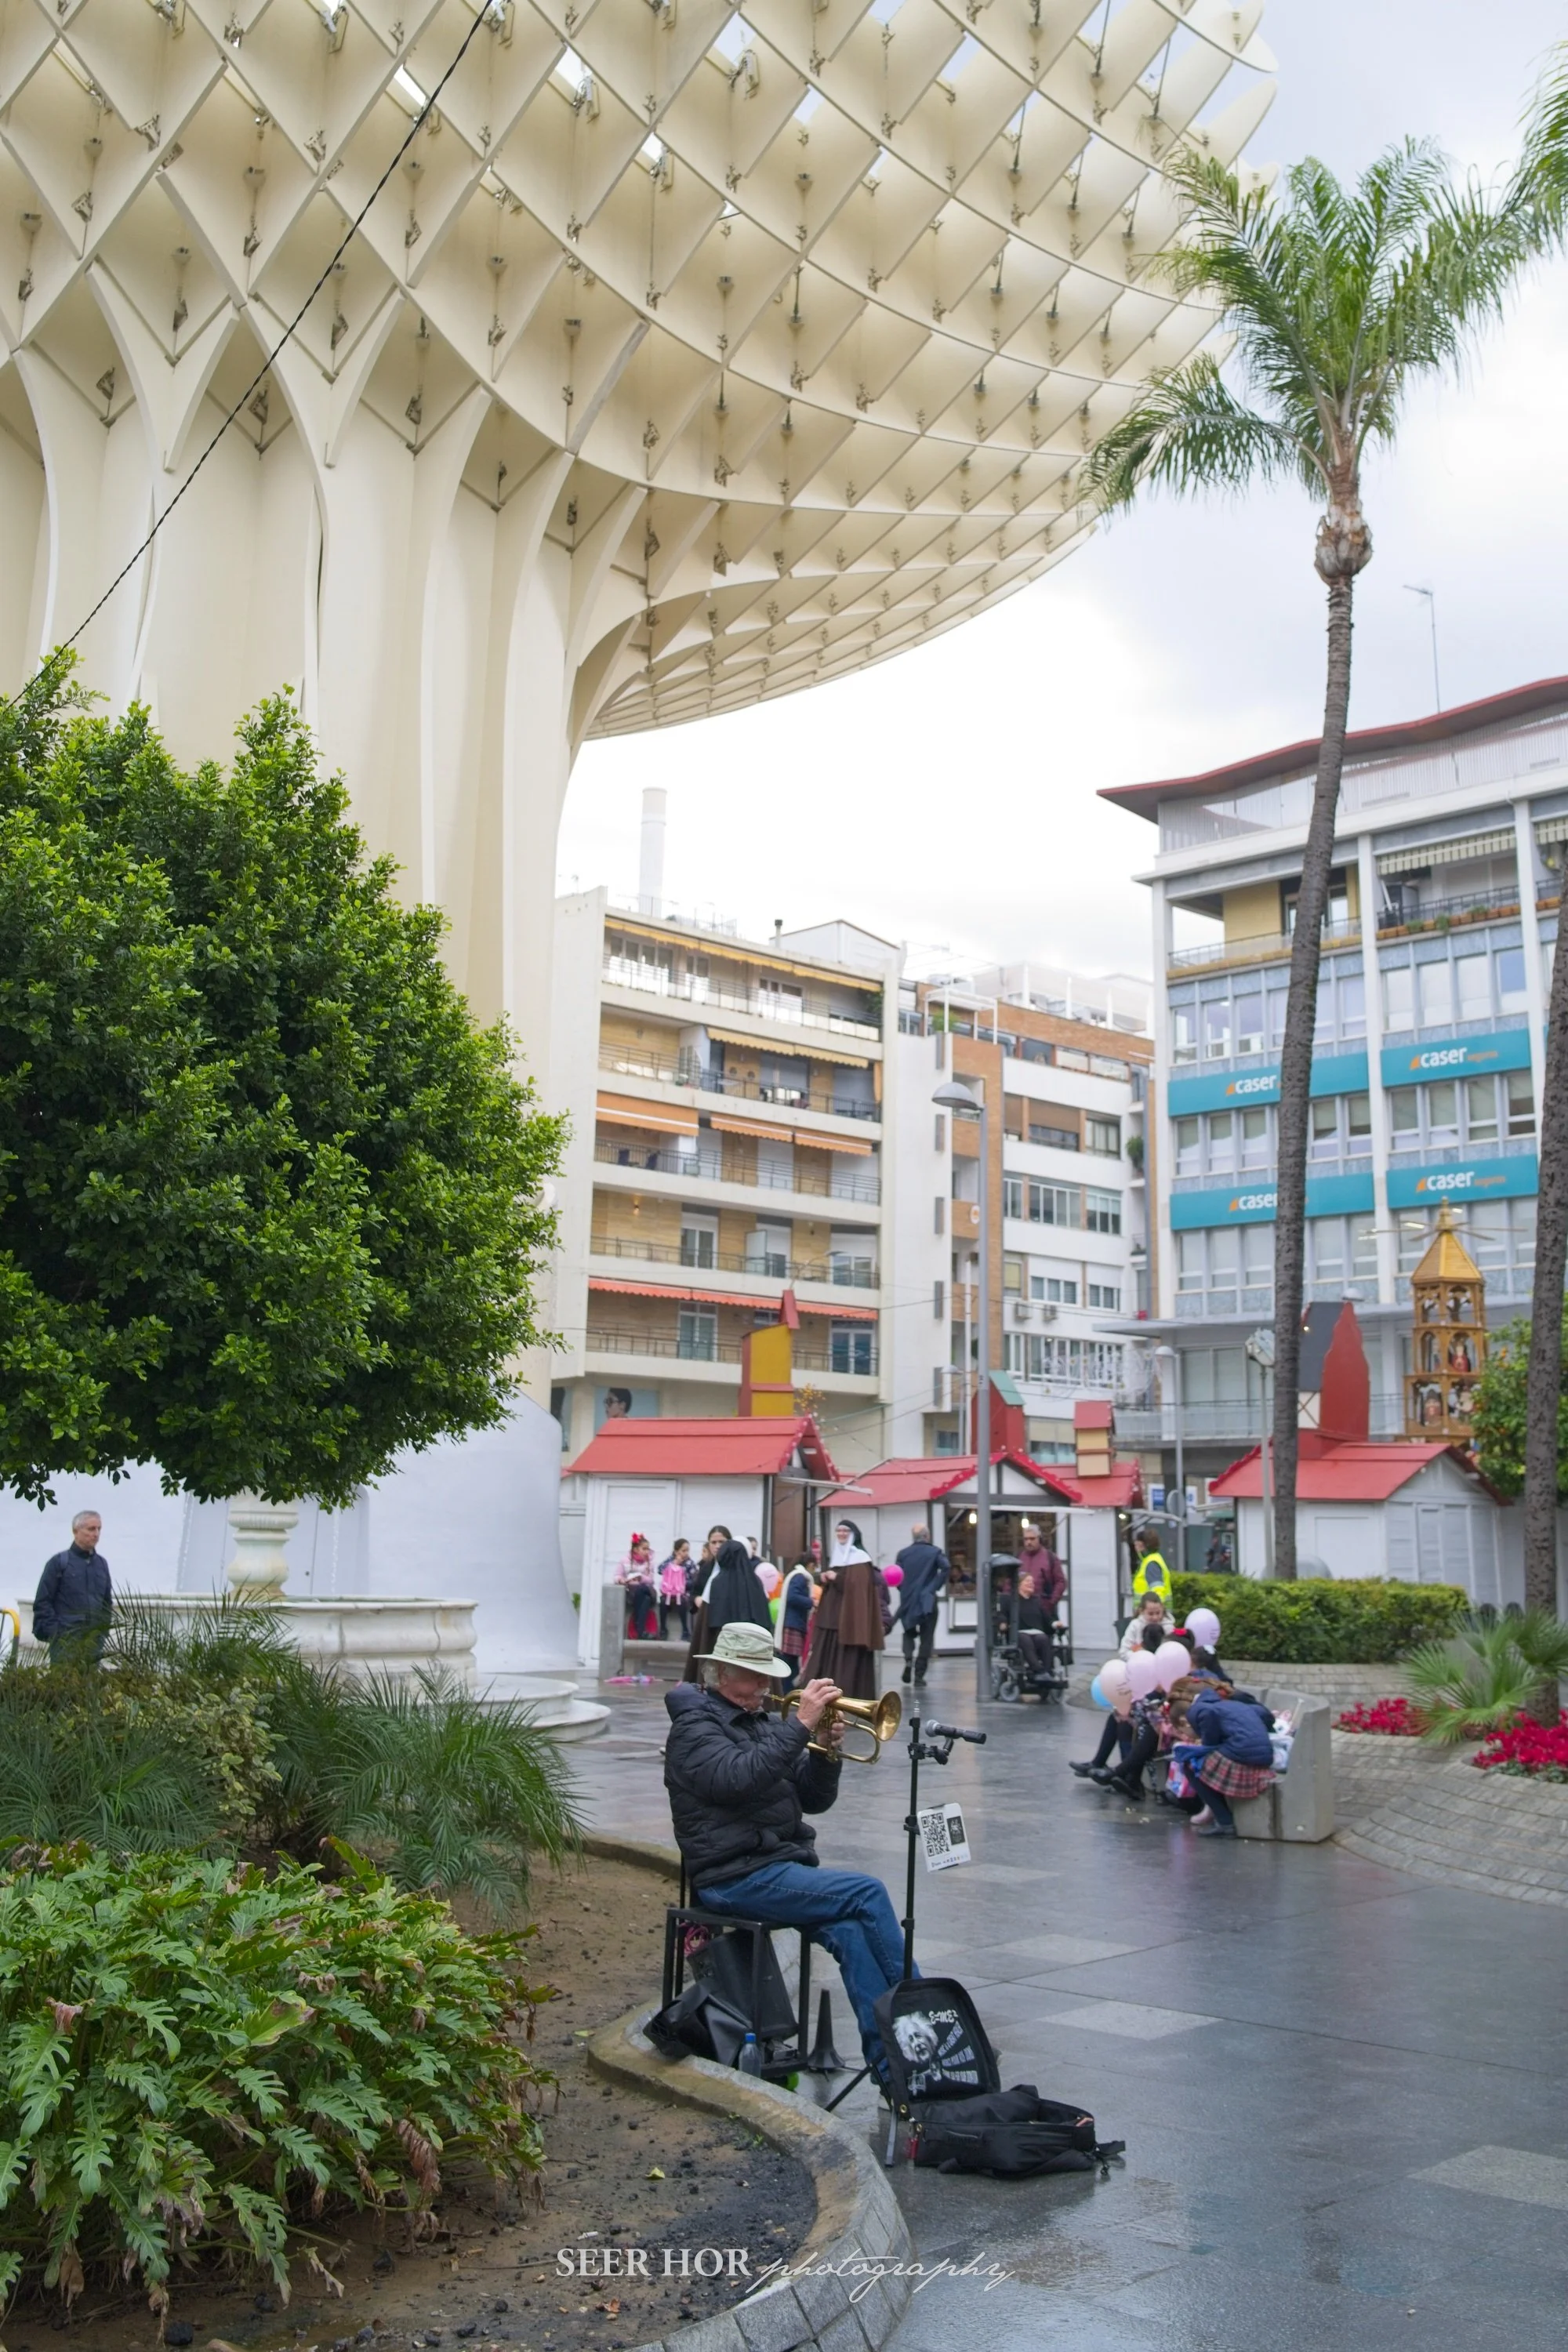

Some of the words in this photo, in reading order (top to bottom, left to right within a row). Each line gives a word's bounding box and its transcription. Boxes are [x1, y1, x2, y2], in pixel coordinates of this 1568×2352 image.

[1420, 1047, 1468, 1068] caser
[1235, 1074, 1277, 1094] caser
[1427, 1171, 1475, 1191] caser
